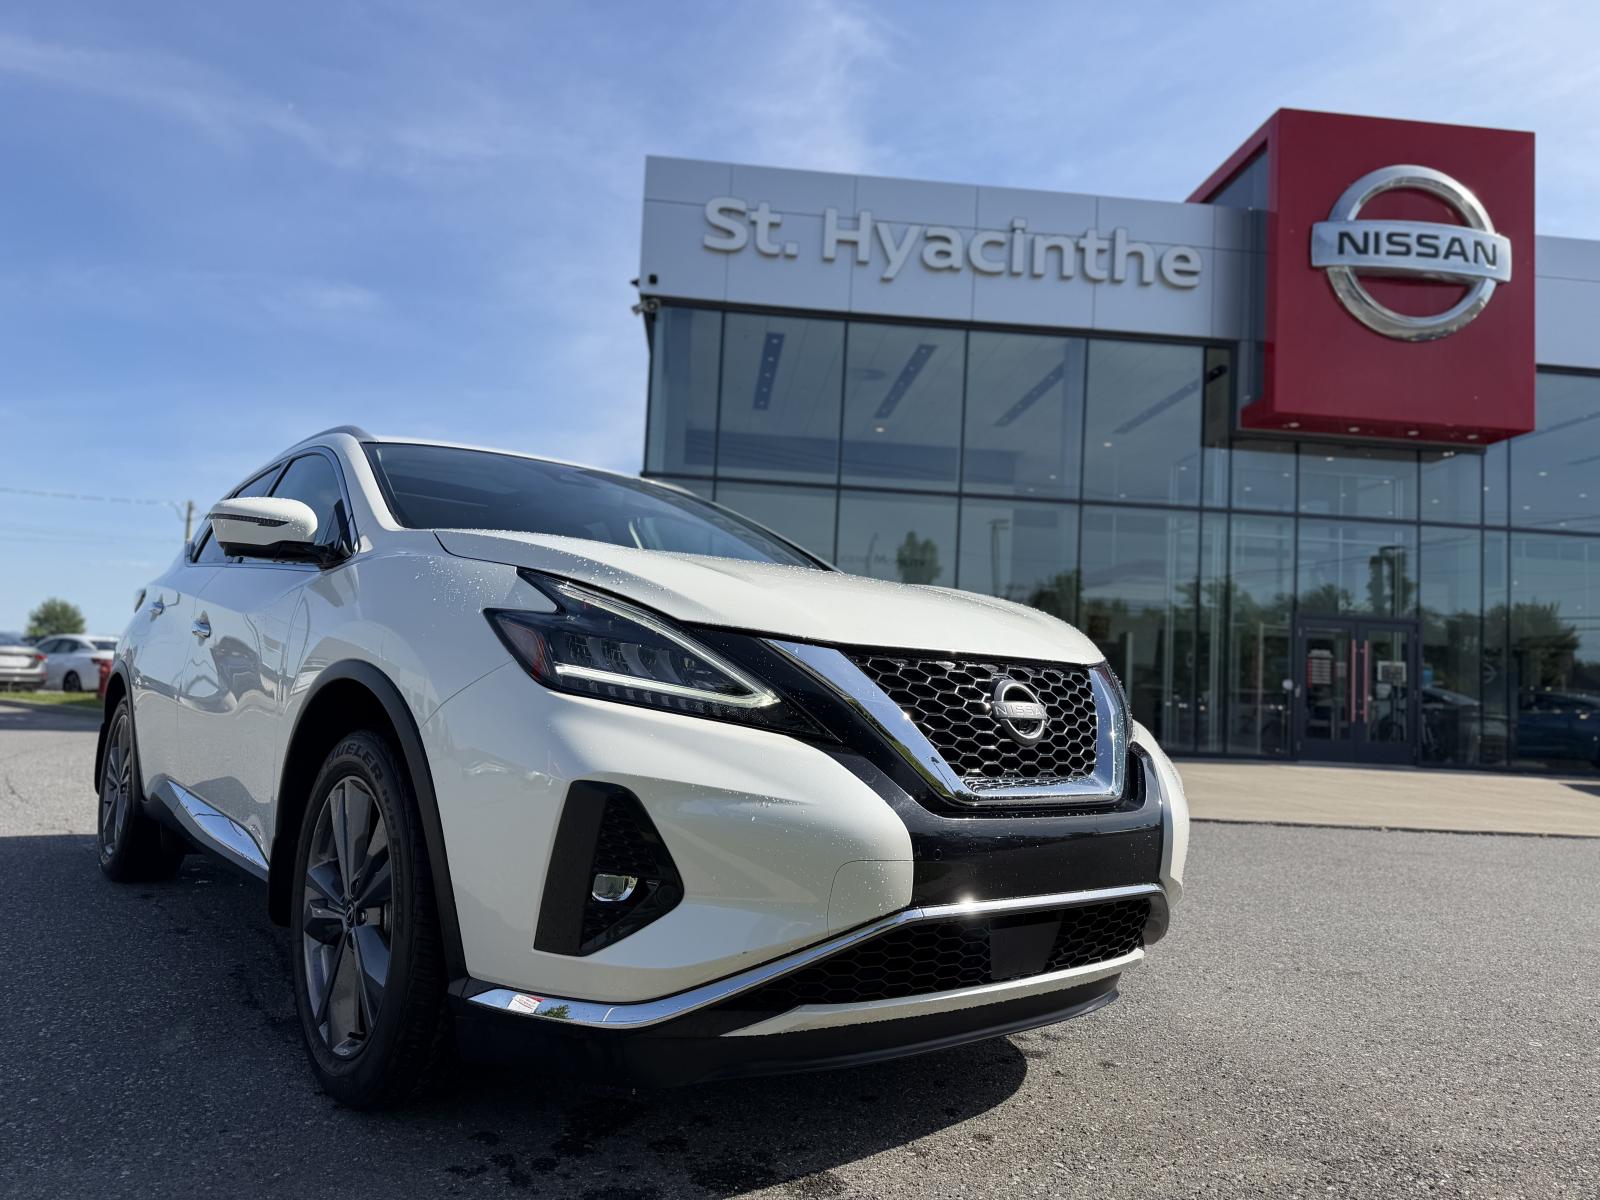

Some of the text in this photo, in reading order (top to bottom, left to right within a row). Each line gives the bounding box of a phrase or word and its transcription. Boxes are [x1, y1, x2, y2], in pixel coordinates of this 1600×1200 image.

[703, 197, 1202, 289] St. Hyacinthe
[1337, 231, 1497, 266] NISSAN
